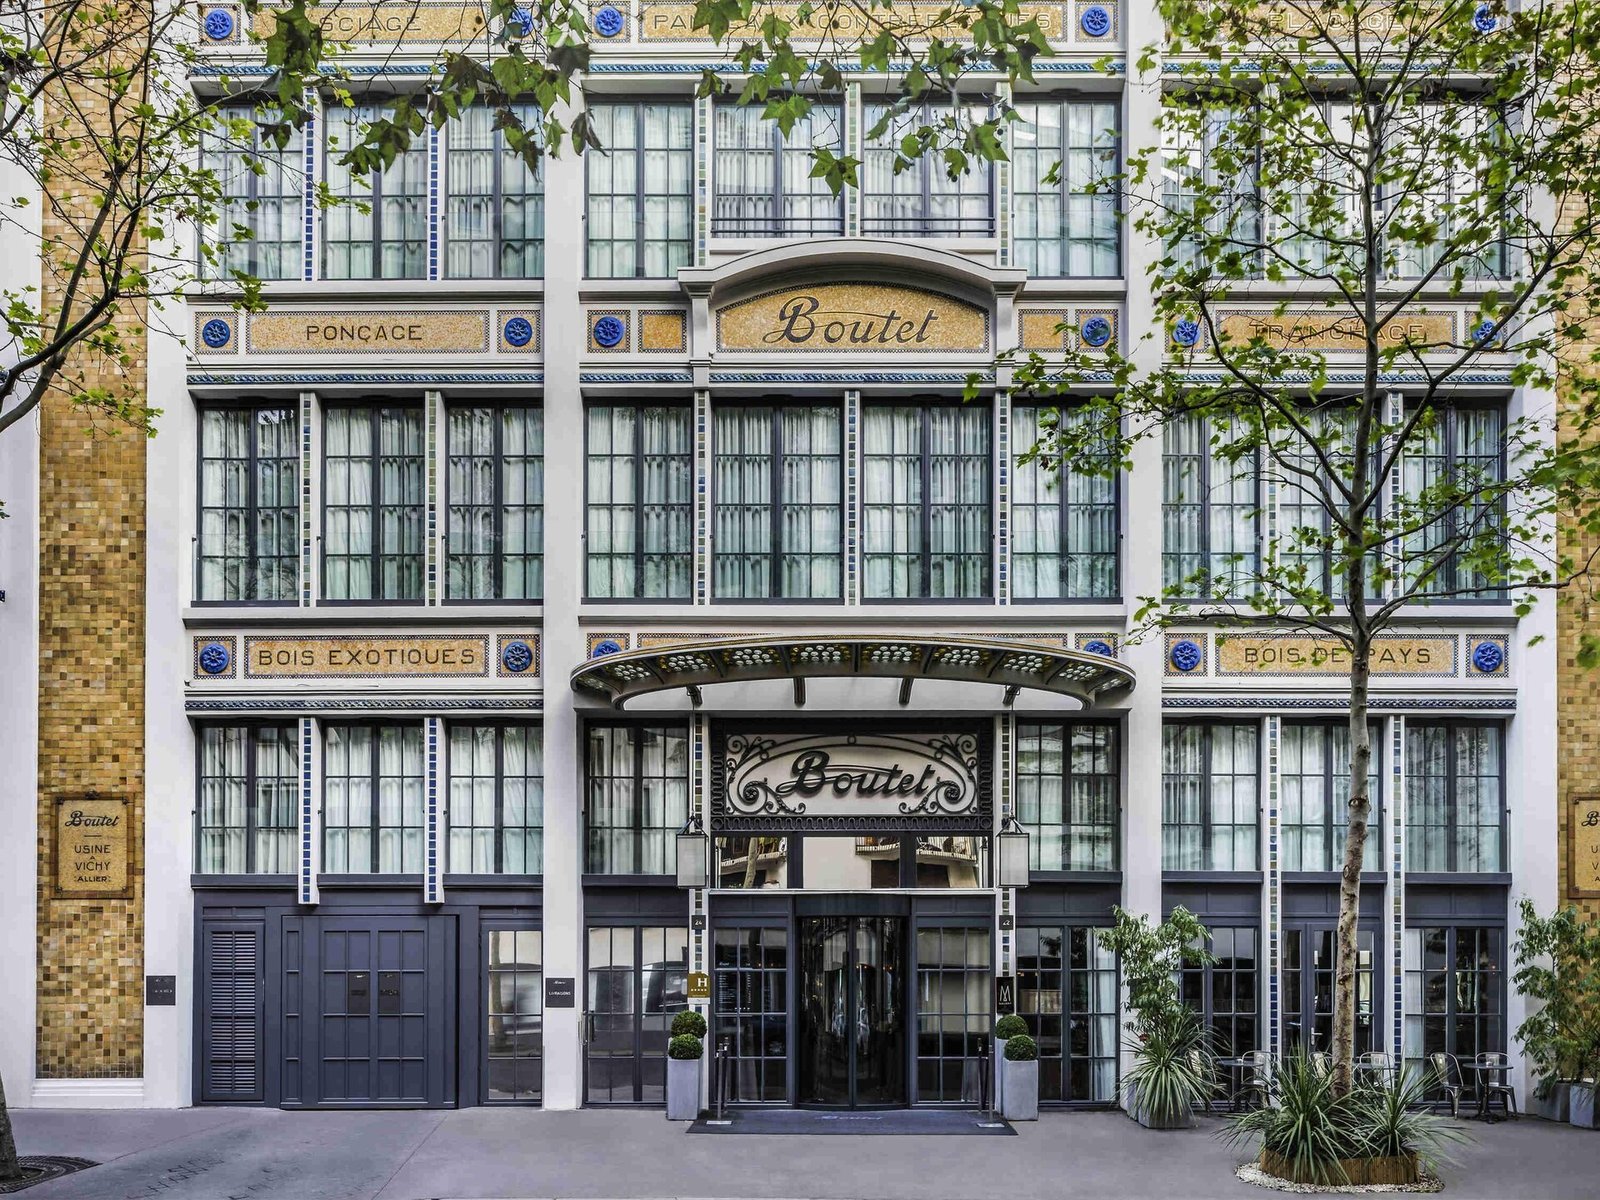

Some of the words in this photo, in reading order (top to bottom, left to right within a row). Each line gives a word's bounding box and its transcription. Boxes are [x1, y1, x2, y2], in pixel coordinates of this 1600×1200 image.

[762, 296, 939, 344] Boutet
[306, 325, 422, 343] PONÇAGE
[258, 649, 314, 666] BOIS
[329, 648, 475, 666] EXOTIQUES
[1244, 647, 1300, 663] BOIS
[1314, 648, 1345, 664] DE
[775, 750, 936, 795] Boutet
[64, 810, 120, 827] Boutet
[74, 845, 111, 854] USINE
[75, 862, 111, 871] VICHY
[697, 978, 708, 987] H
